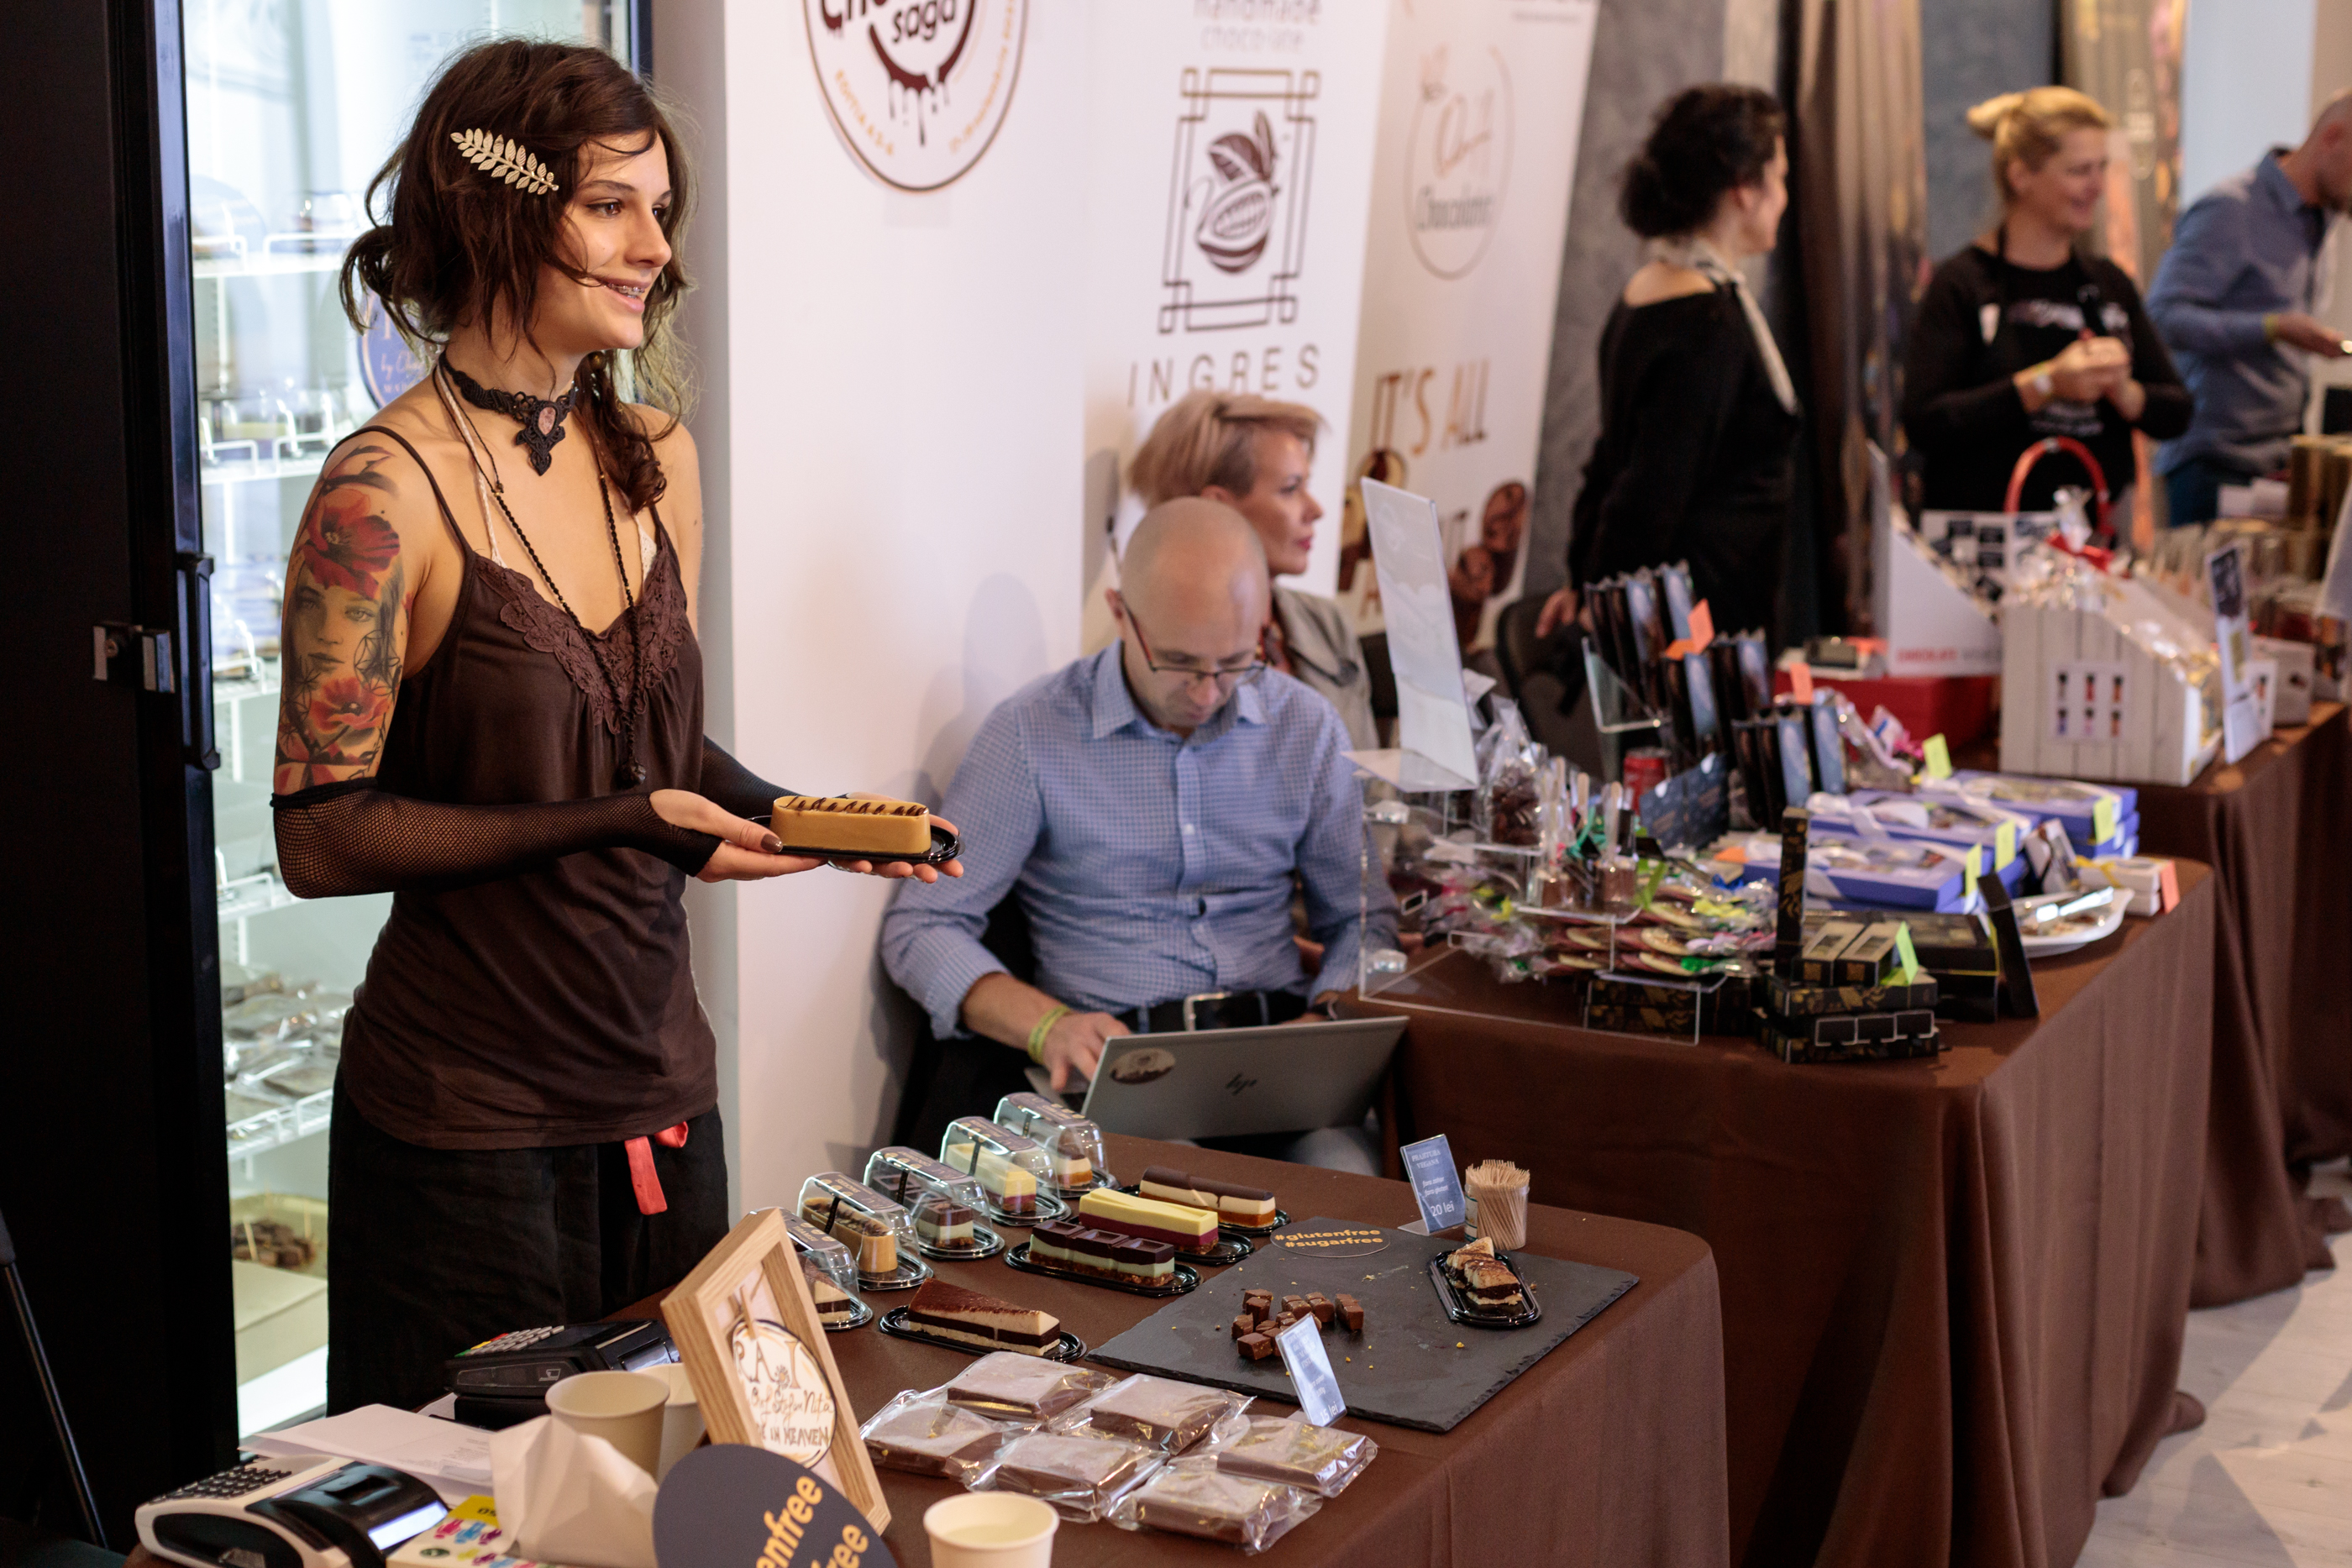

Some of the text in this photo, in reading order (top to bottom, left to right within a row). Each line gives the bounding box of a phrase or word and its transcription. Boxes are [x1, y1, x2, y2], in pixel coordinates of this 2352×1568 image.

[1127, 343, 1320, 408] INGRES
[1416, 1158, 1440, 1169] VEGANA
[1431, 1200, 1455, 1217] 20 lei
[1274, 1229, 1381, 1241] #glutenfree
[1284, 1237, 1383, 1248] #sugarfree
[1320, 1400, 1339, 1424] 15 lei
[783, 1426, 830, 1448] HEAVEN
